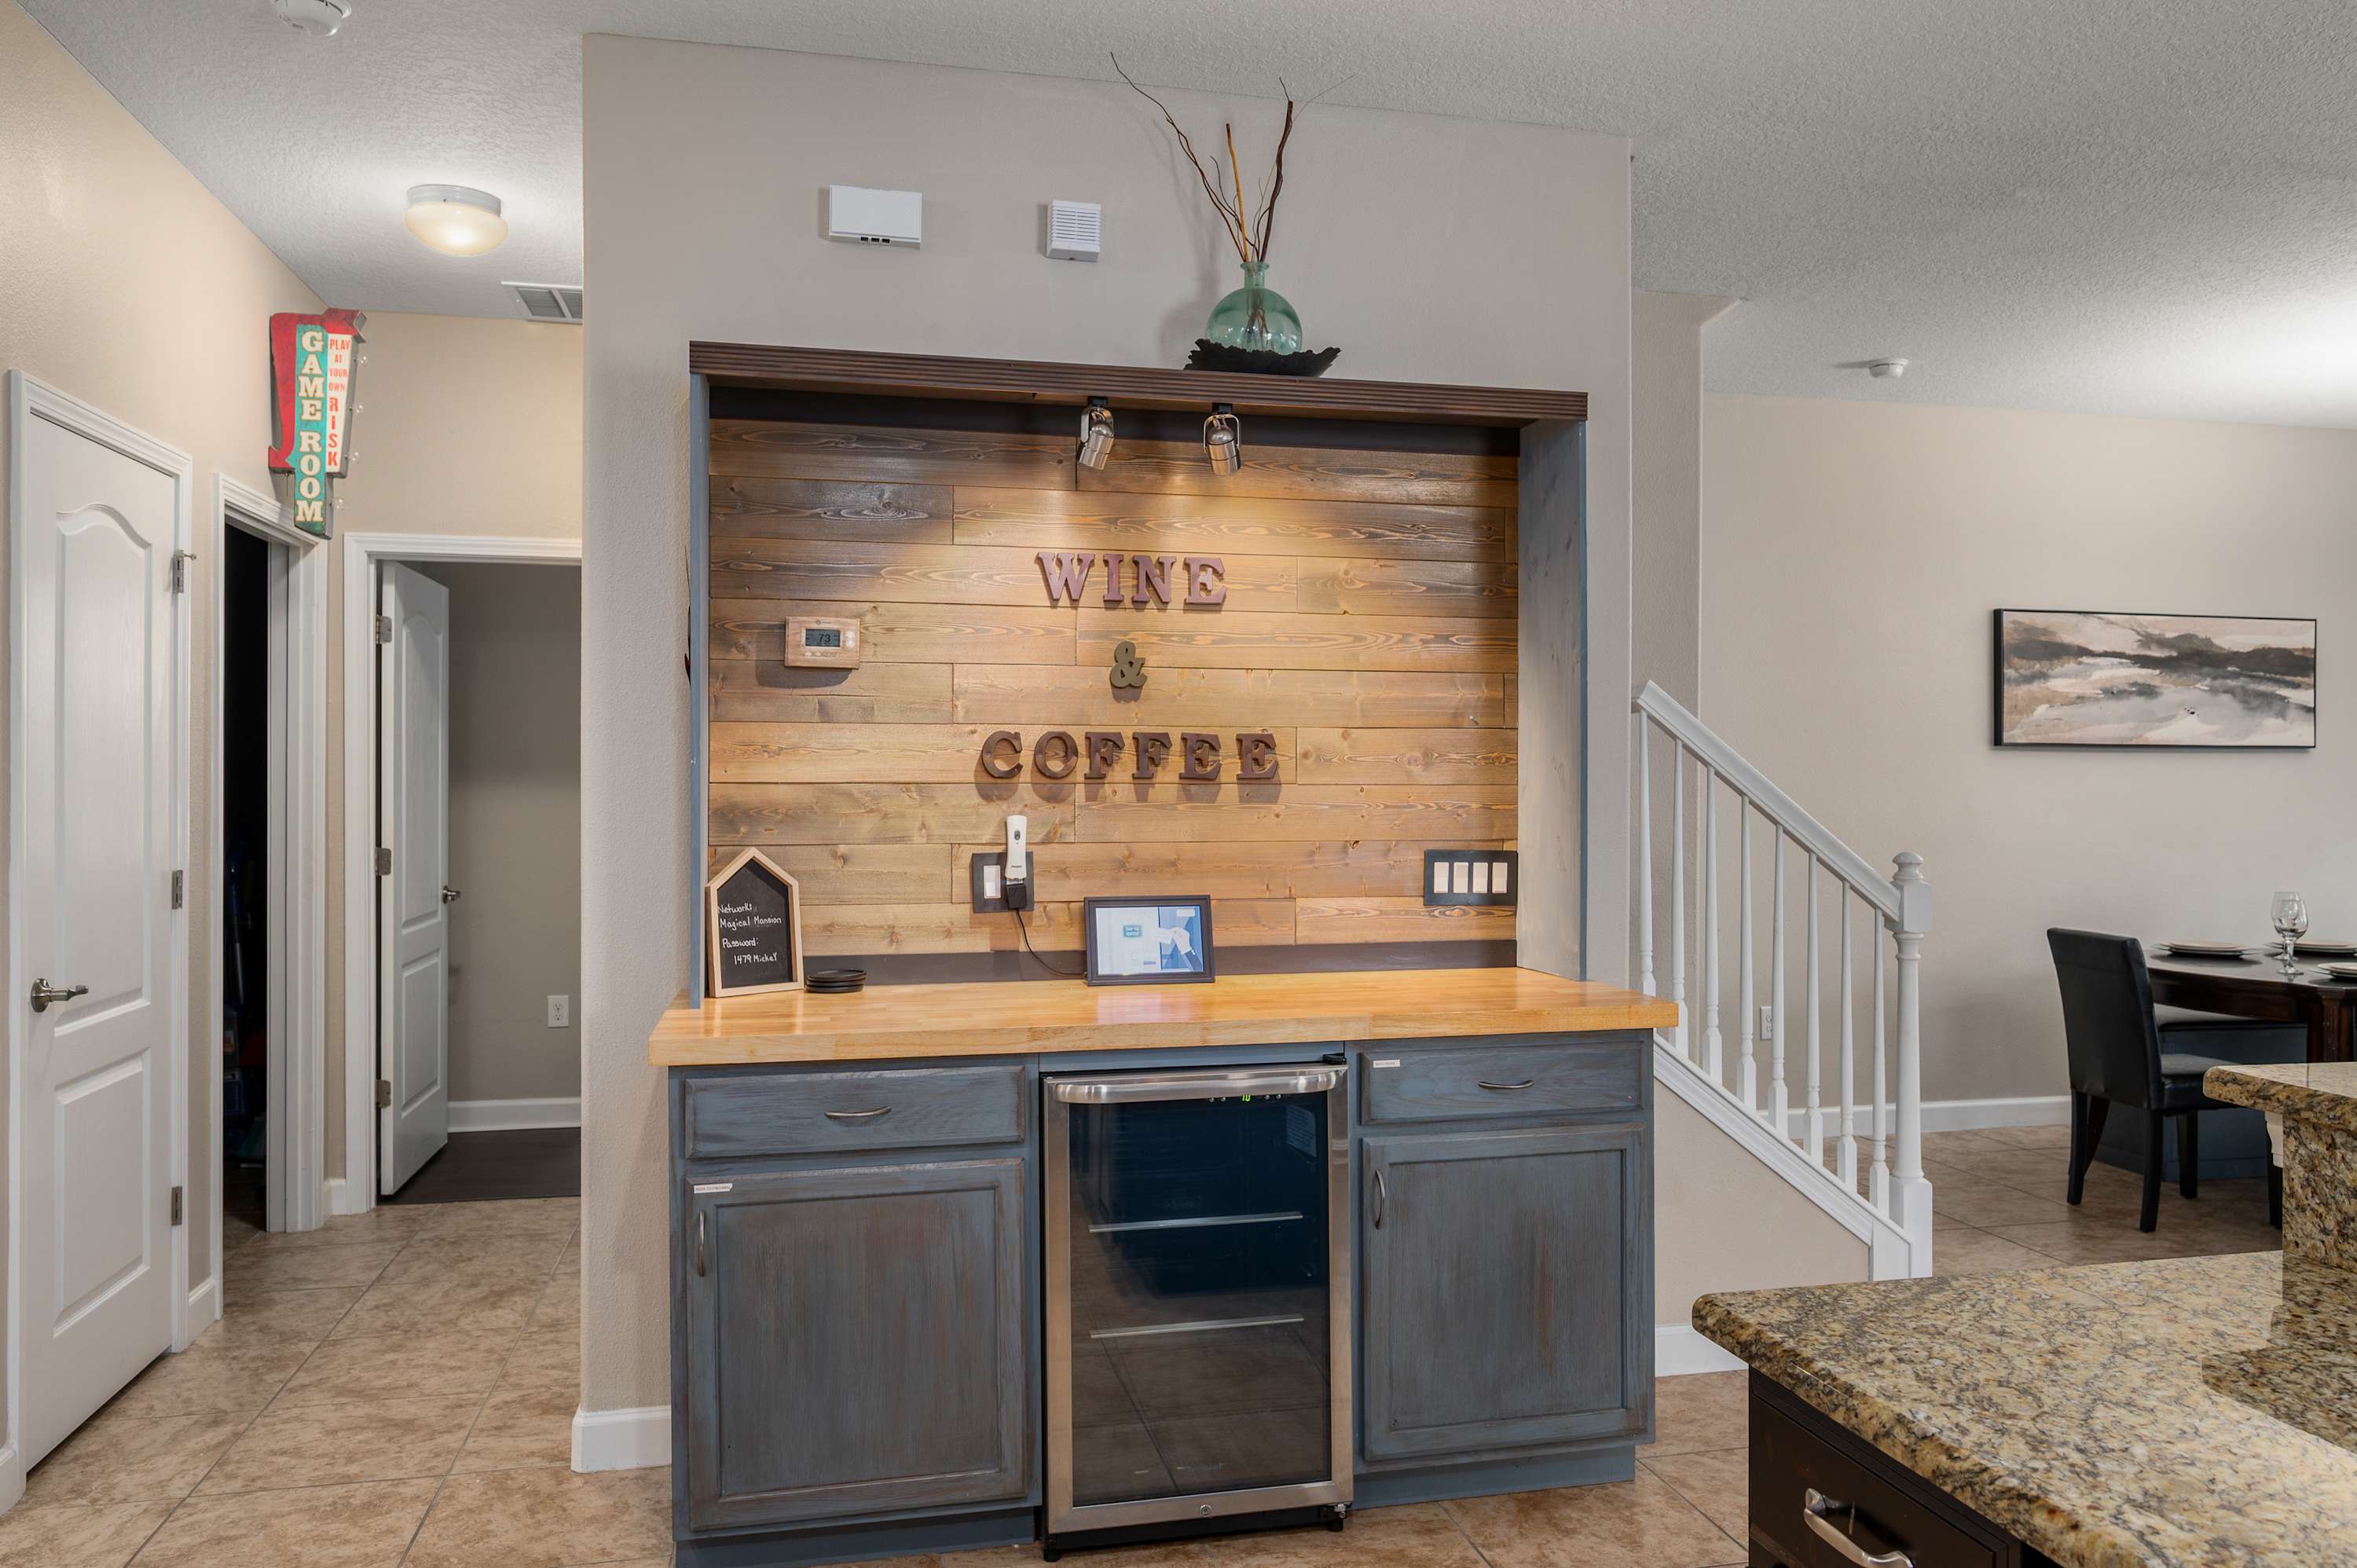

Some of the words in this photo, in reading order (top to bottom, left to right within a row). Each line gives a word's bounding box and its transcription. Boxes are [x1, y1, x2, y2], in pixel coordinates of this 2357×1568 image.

[330, 339, 350, 350] PLAY
[335, 354, 343, 364] AT
[299, 331, 325, 421] GAME
[329, 368, 347, 378] YOUR
[328, 383, 346, 392] OWN
[328, 397, 339, 466] RISK
[296, 430, 324, 522] ROOM
[1036, 552, 1227, 604] WINE
[1109, 640, 1148, 688] &
[981, 730, 1280, 780] COFFEE
[720, 916, 750, 930] Magical
[754, 914, 782, 925] Mansion
[722, 937, 759, 948] Password:
[734, 954, 752, 965] 1479
